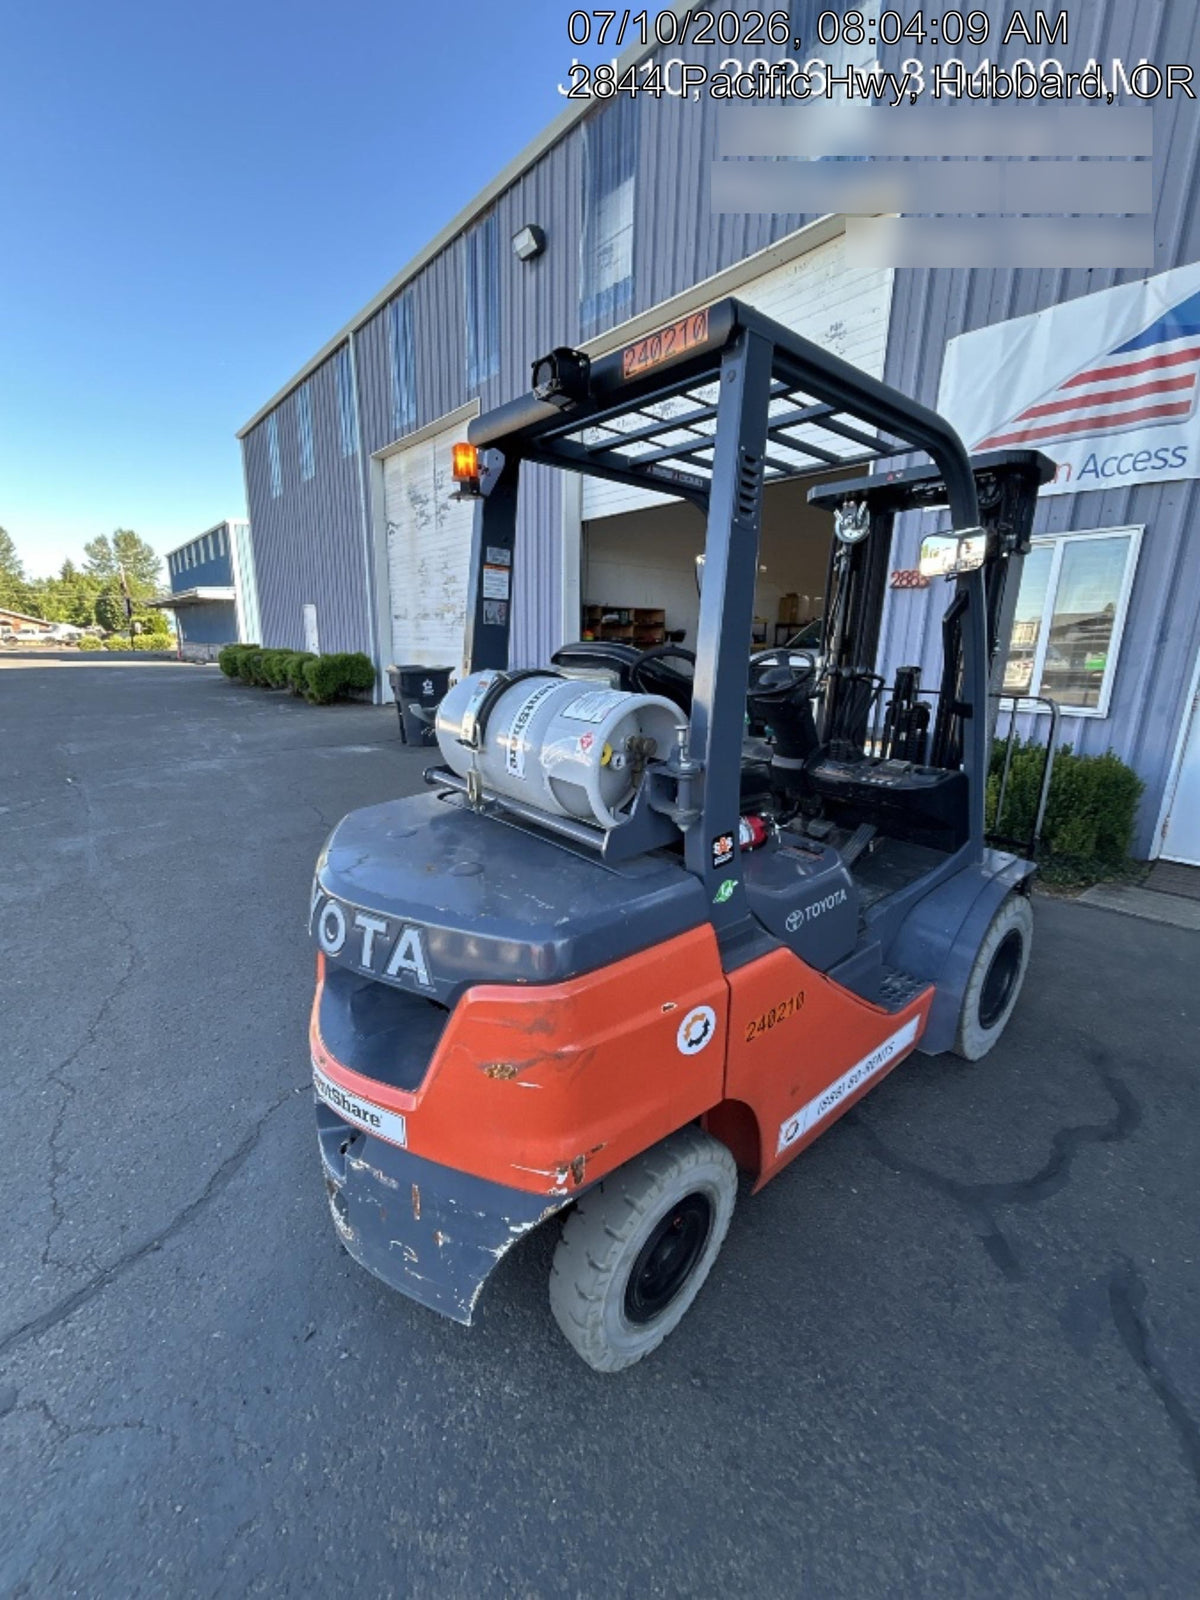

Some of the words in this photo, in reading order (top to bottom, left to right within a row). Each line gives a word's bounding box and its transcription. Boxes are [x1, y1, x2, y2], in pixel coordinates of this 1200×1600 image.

[625, 312, 707, 377] 240210
[1077, 446, 1189, 481] Access
[804, 889, 847, 921] TOYOTA
[746, 990, 805, 1043] 240210
